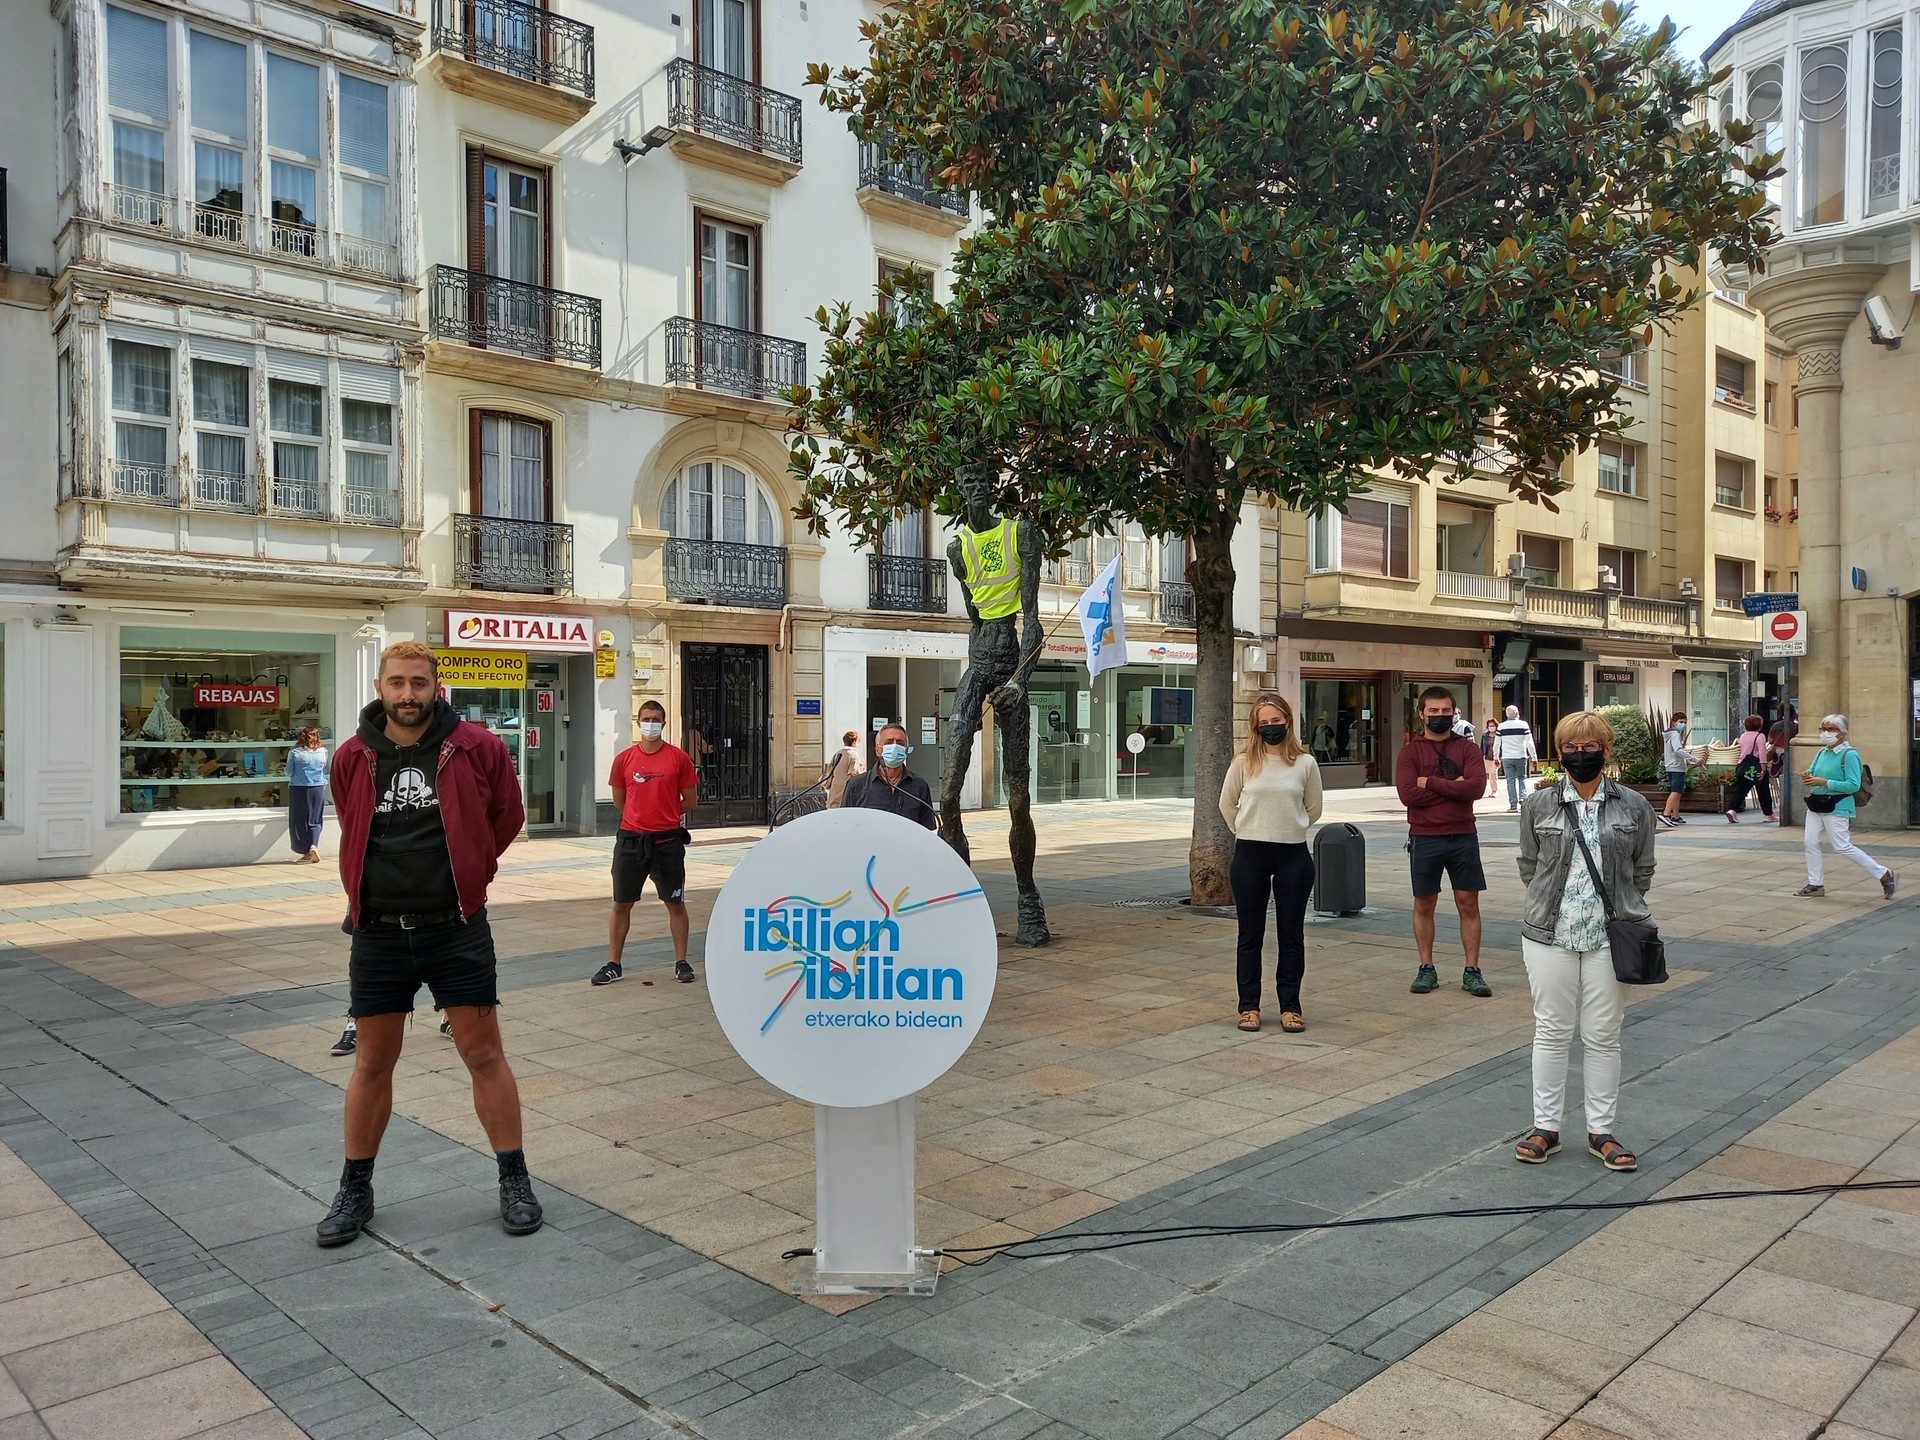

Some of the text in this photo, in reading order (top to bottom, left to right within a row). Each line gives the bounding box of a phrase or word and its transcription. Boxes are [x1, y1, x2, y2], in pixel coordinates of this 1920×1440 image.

[1047, 643, 1086, 654] TotalEnergies
[1300, 651, 1335, 663] URBIETA
[494, 658, 523, 670] ORO
[1626, 659, 1660, 669] TERIA YABAR
[438, 671, 524, 682] AGO EN EFECTIVO
[1603, 673, 1631, 682] TERIA YABAR
[199, 689, 275, 703] REBAJAS
[743, 907, 900, 952] ibilian
[805, 955, 964, 1001] ibilian
[804, 1010, 963, 1028] etxerako bidean
